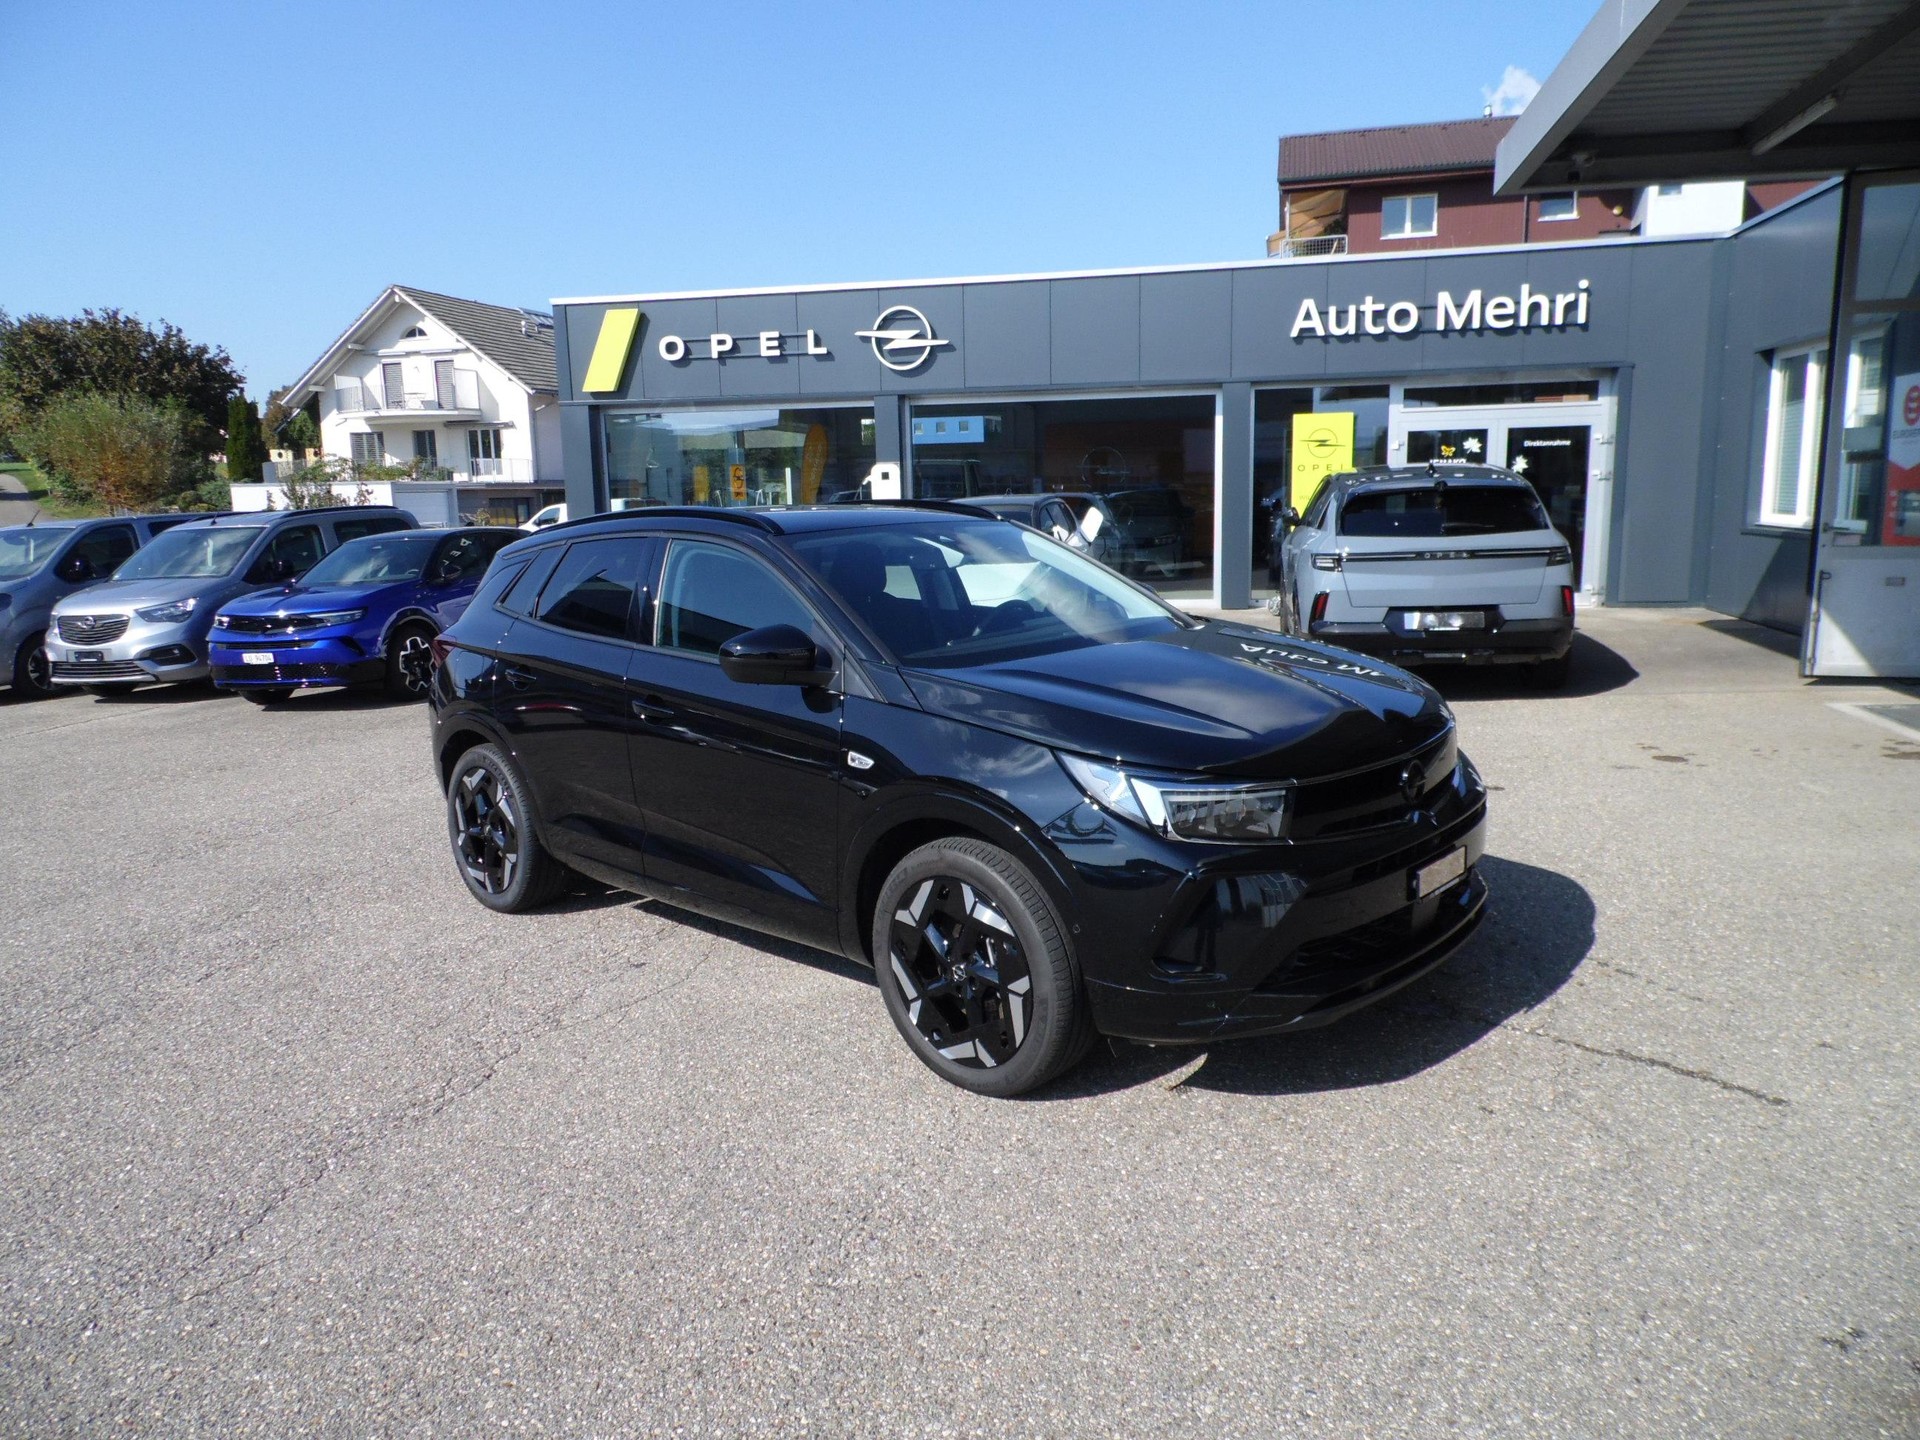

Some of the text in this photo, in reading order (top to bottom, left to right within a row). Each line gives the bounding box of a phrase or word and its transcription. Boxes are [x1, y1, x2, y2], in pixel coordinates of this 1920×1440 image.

[1290, 279, 1590, 338] Auto Mehri
[659, 329, 828, 361] OPEL
[1523, 439, 1571, 447] Direktannahme
